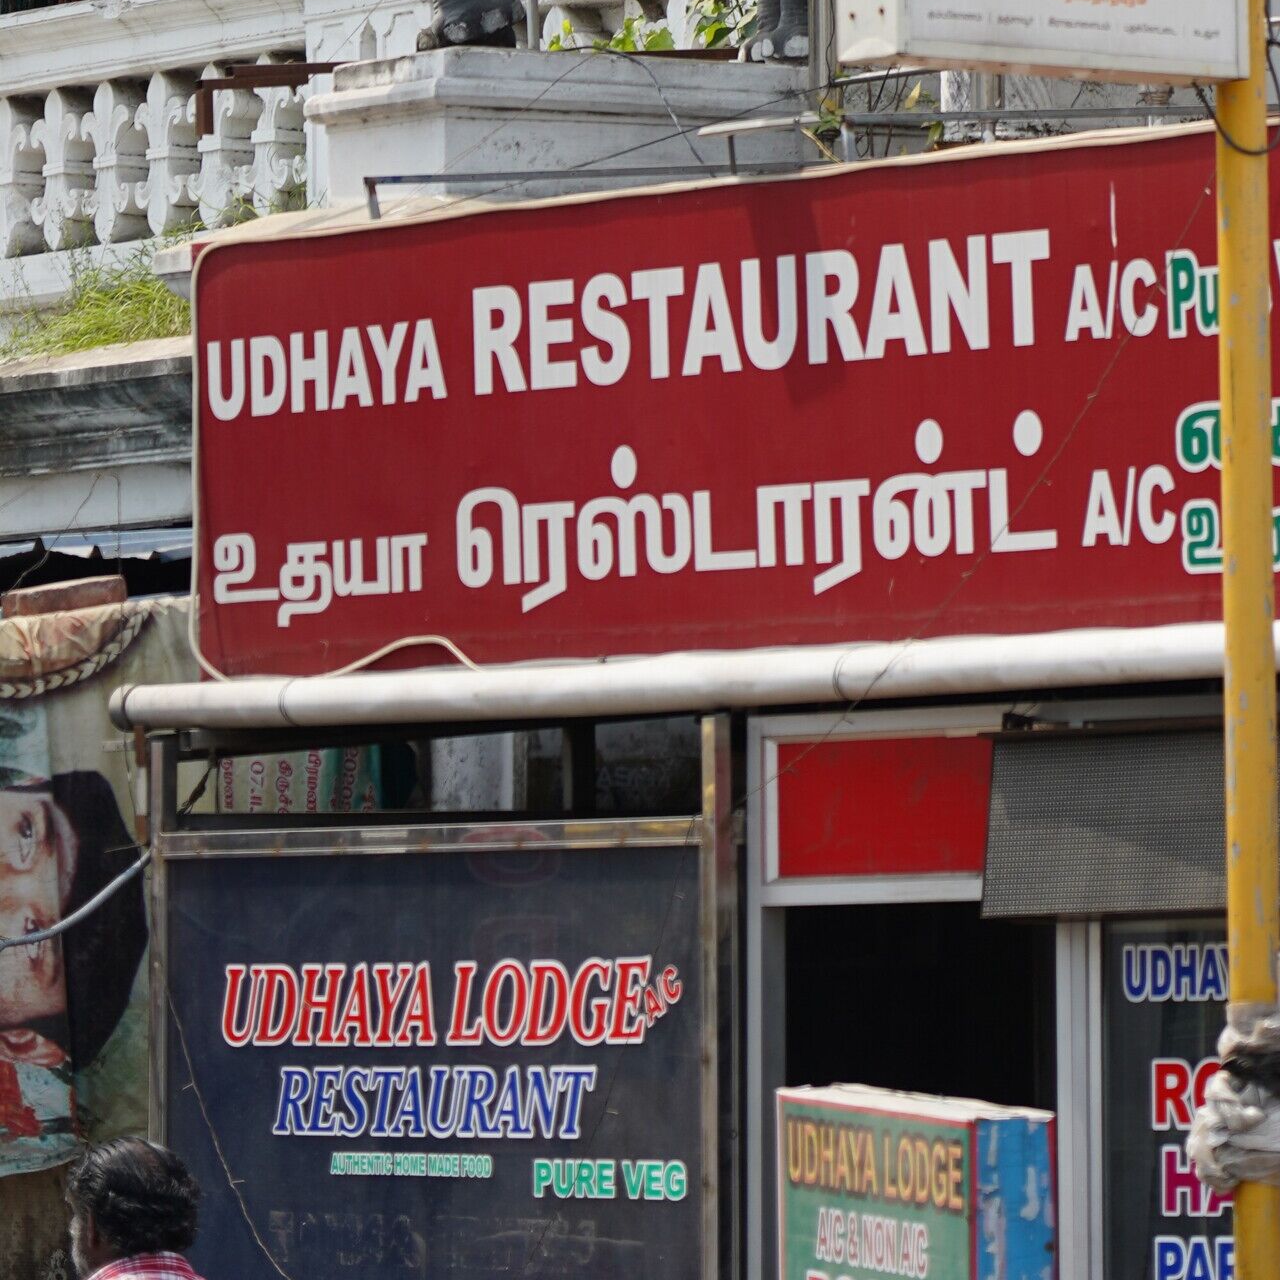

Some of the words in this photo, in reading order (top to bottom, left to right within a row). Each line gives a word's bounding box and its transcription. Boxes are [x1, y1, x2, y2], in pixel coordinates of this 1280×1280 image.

[206, 318, 448, 421] UDHAYA
[472, 228, 1050, 396] RESTAURANT
[1064, 257, 1159, 341] A/C
[1165, 248, 1272, 339] Pu
[212, 532, 428, 628] உதயா
[455, 408, 1058, 613] ரெஸ்டாரன்ட்
[1081, 464, 1177, 548] A/C
[221, 960, 437, 1047] UDHAYA
[446, 955, 653, 1047] LODGE
[642, 964, 684, 1029] A/C
[272, 1065, 598, 1140] RESTAURANT
[330, 1152, 393, 1176] AUTHENTIC
[394, 1153, 427, 1177] HOME
[427, 1154, 460, 1178] MADE
[460, 1155, 493, 1178] FOOD
[533, 1159, 616, 1199] PURE
[622, 1160, 688, 1201] VEG
[787, 1117, 879, 1196] UDHAYA
[884, 1134, 964, 1211] LODGE
[816, 1206, 845, 1264] A/C
[847, 1211, 860, 1268] &
[860, 1213, 898, 1275] NON
[898, 1221, 929, 1279] A/C
